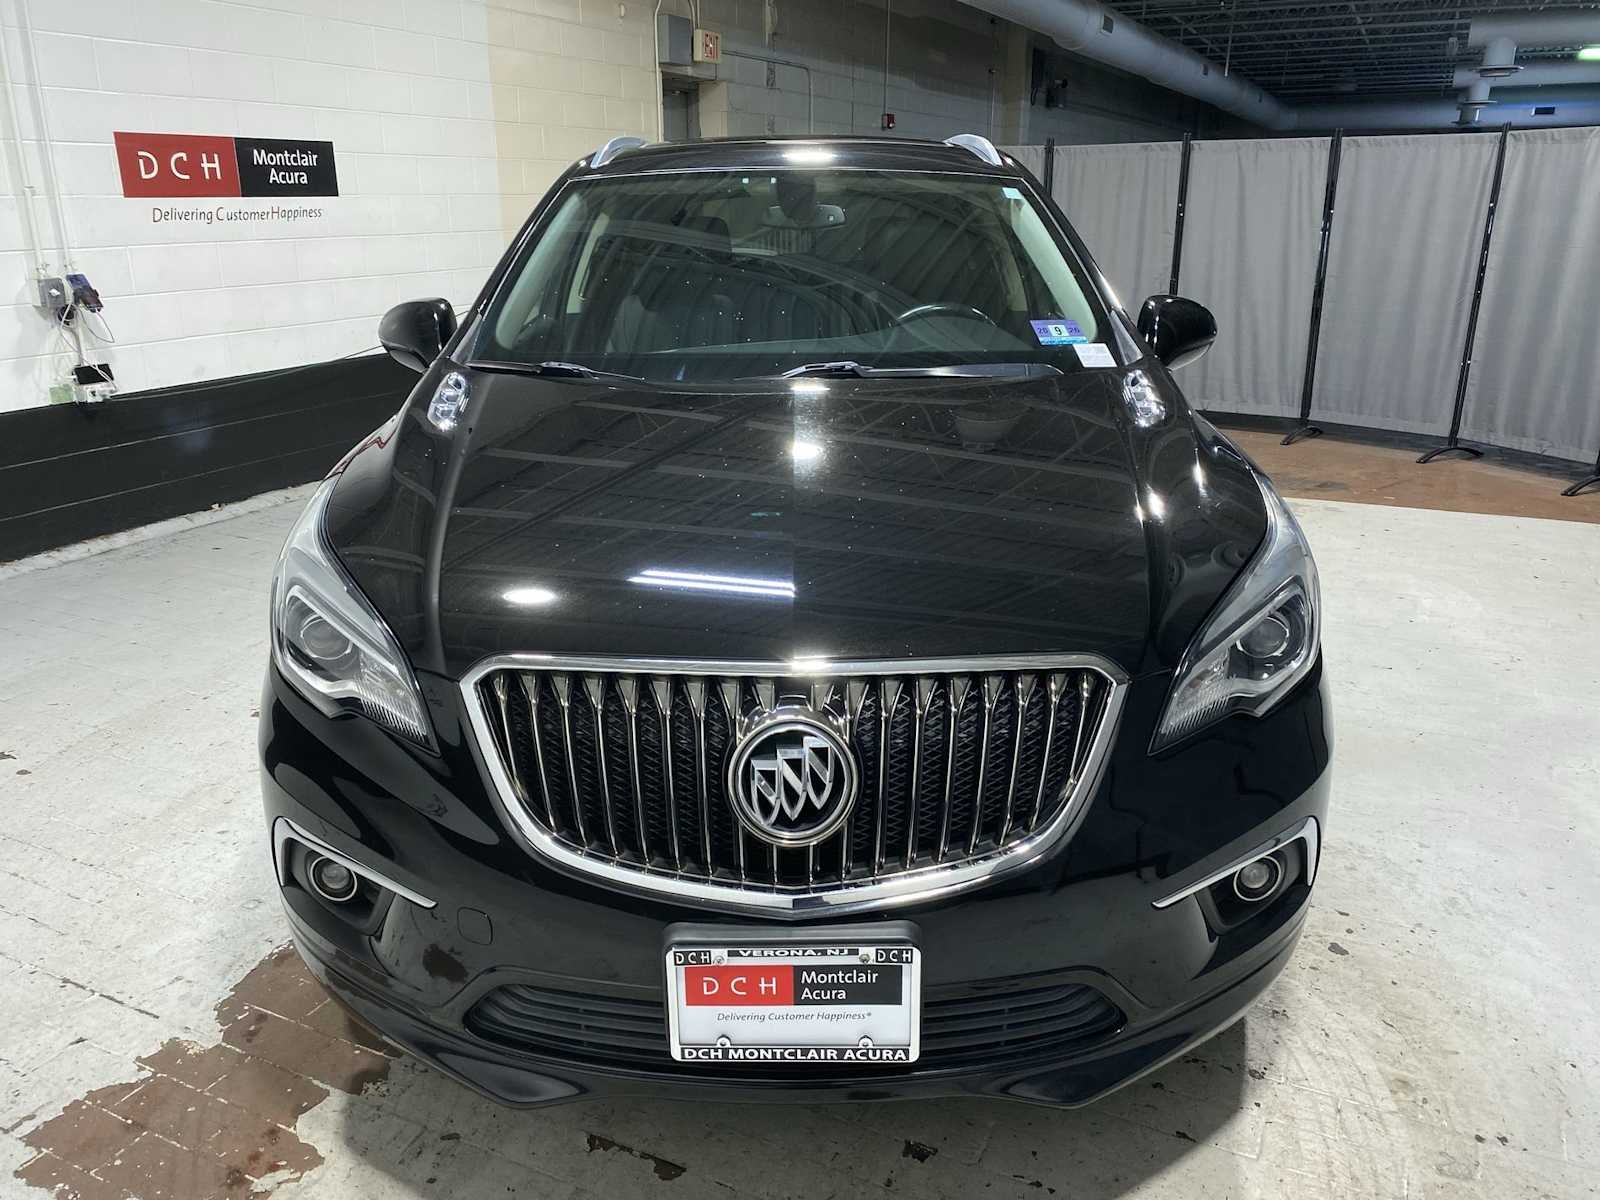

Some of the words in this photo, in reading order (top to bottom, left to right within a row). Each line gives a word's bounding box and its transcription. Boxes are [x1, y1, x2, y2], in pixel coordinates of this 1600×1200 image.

[253, 149, 318, 167] Montclair
[269, 168, 308, 184] Acura
[152, 207, 213, 224] Delivering
[215, 207, 270, 222] Customer
[271, 206, 322, 222] Happiness
[1054, 326, 1062, 336] 9
[675, 953, 711, 965] DCH
[876, 949, 912, 963] DCH
[800, 970, 878, 985] Montclair
[800, 987, 847, 1001] Acura
[716, 1012, 766, 1022] Delivering
[768, 1011, 815, 1021] Customer
[683, 1048, 723, 1060] DCH
[728, 1048, 839, 1060] MONTCLAIR
[843, 1048, 907, 1061] ACURA
